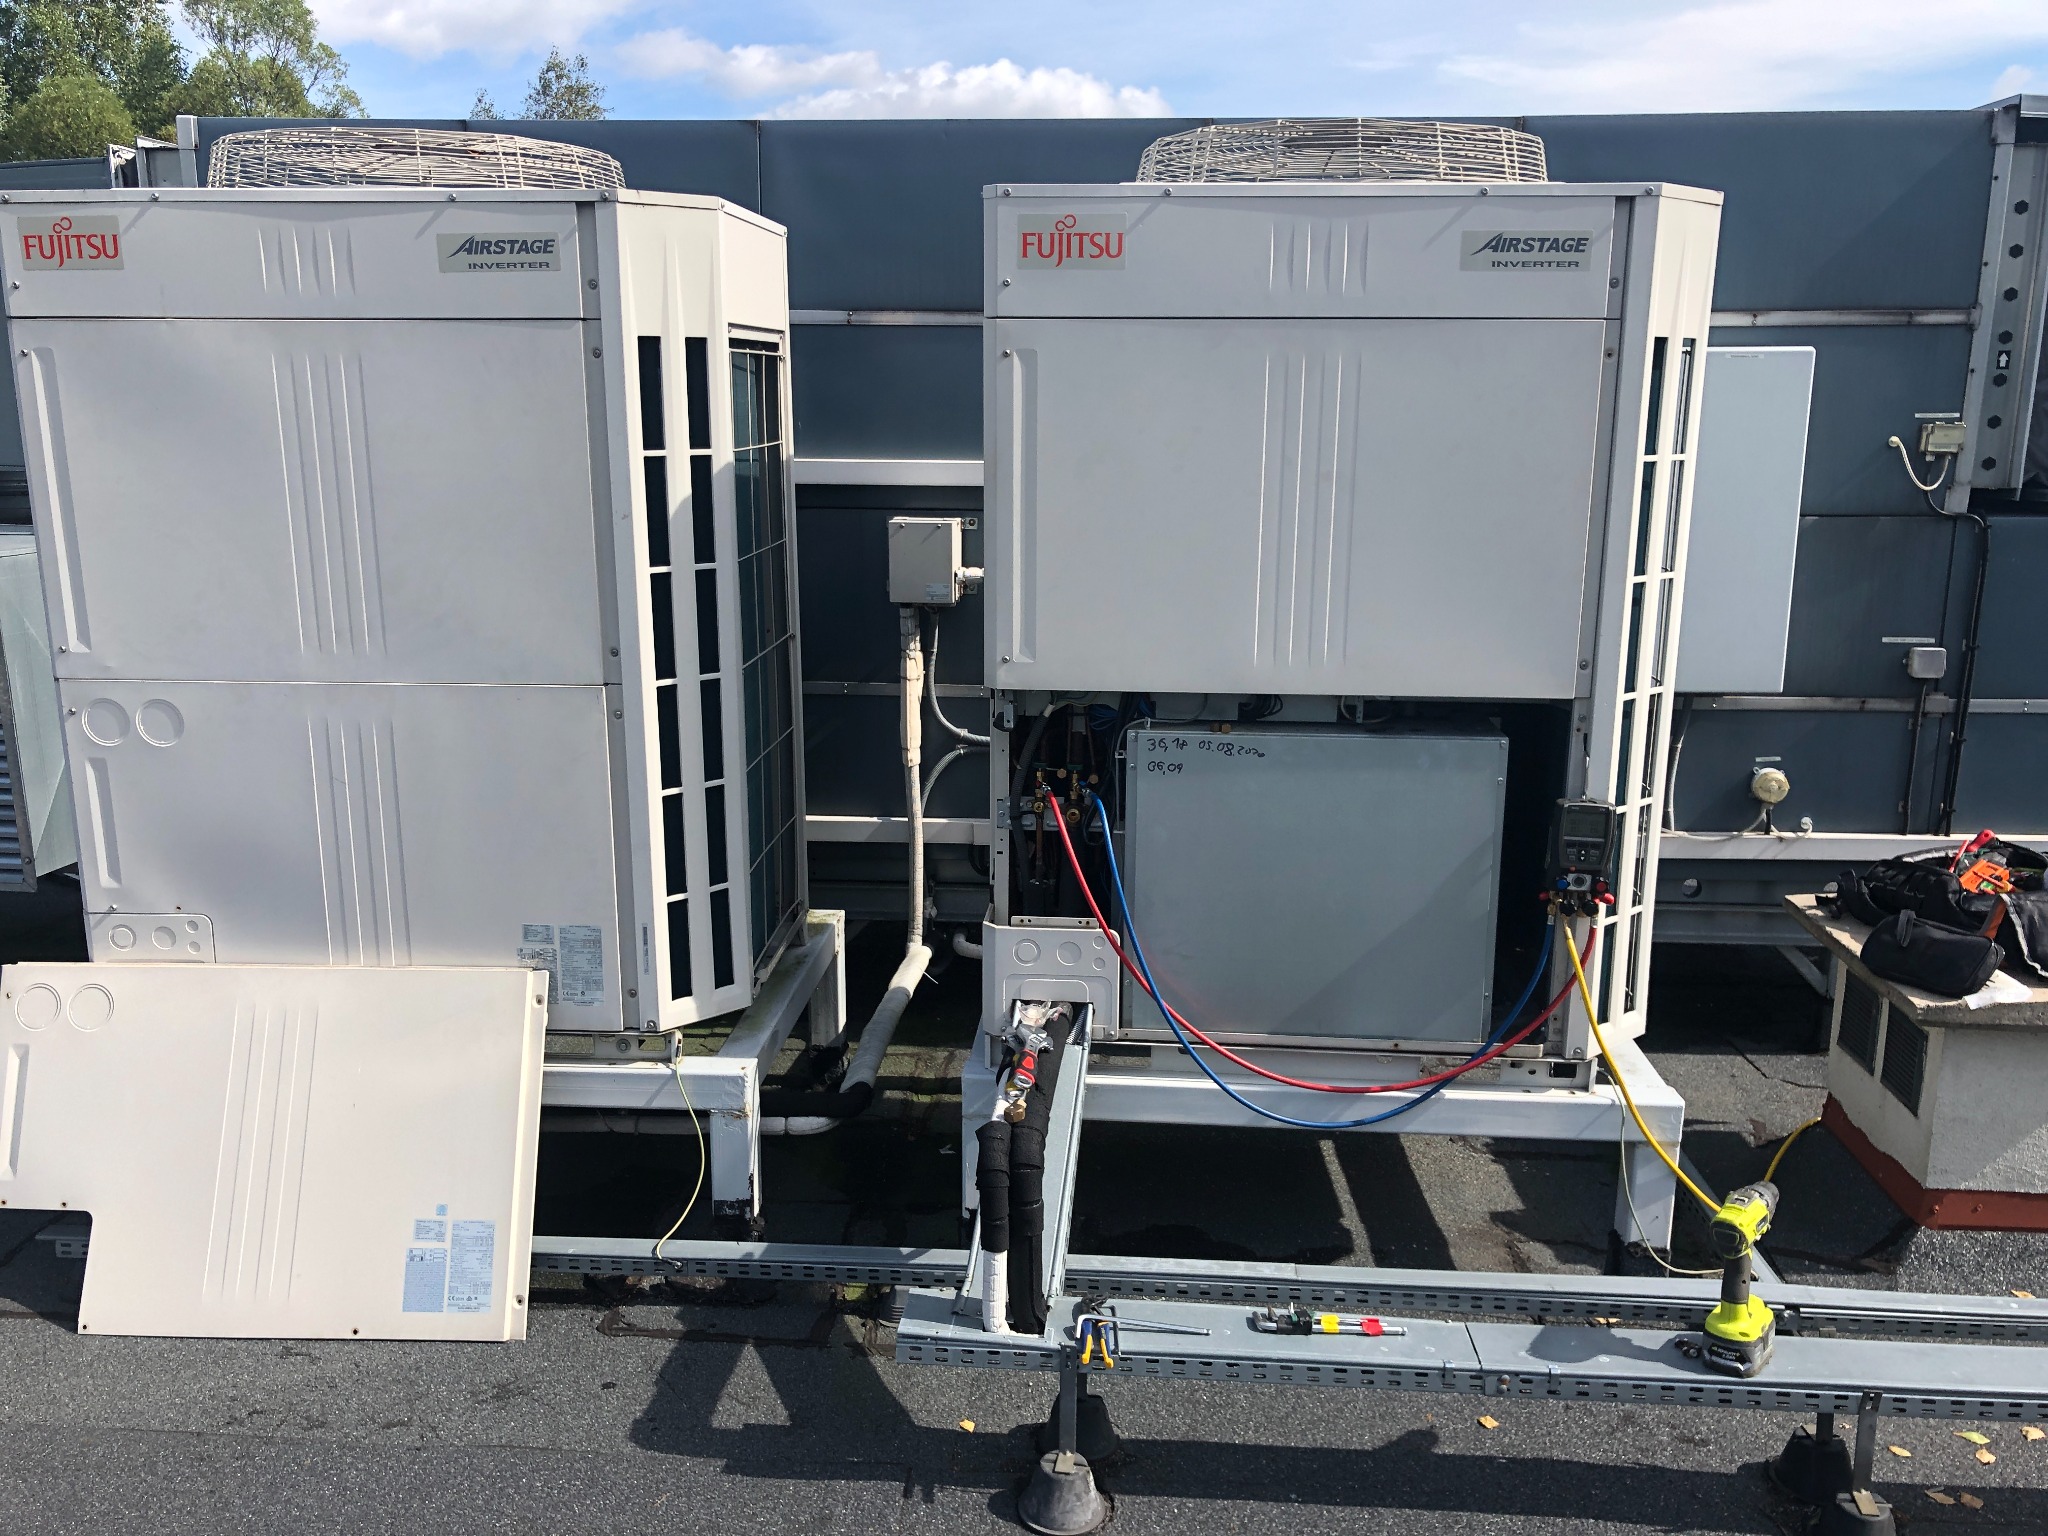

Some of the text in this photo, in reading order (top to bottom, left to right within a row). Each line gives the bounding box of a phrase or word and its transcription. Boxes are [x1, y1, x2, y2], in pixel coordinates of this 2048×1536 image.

[22, 217, 119, 268] FUJITSU
[446, 235, 556, 259] AIRSTAGE
[1021, 214, 1124, 267] FUJITSU
[1470, 232, 1590, 256] AIRSTAGE
[468, 262, 551, 270] INVERTER
[1491, 260, 1580, 268] INVERTER
